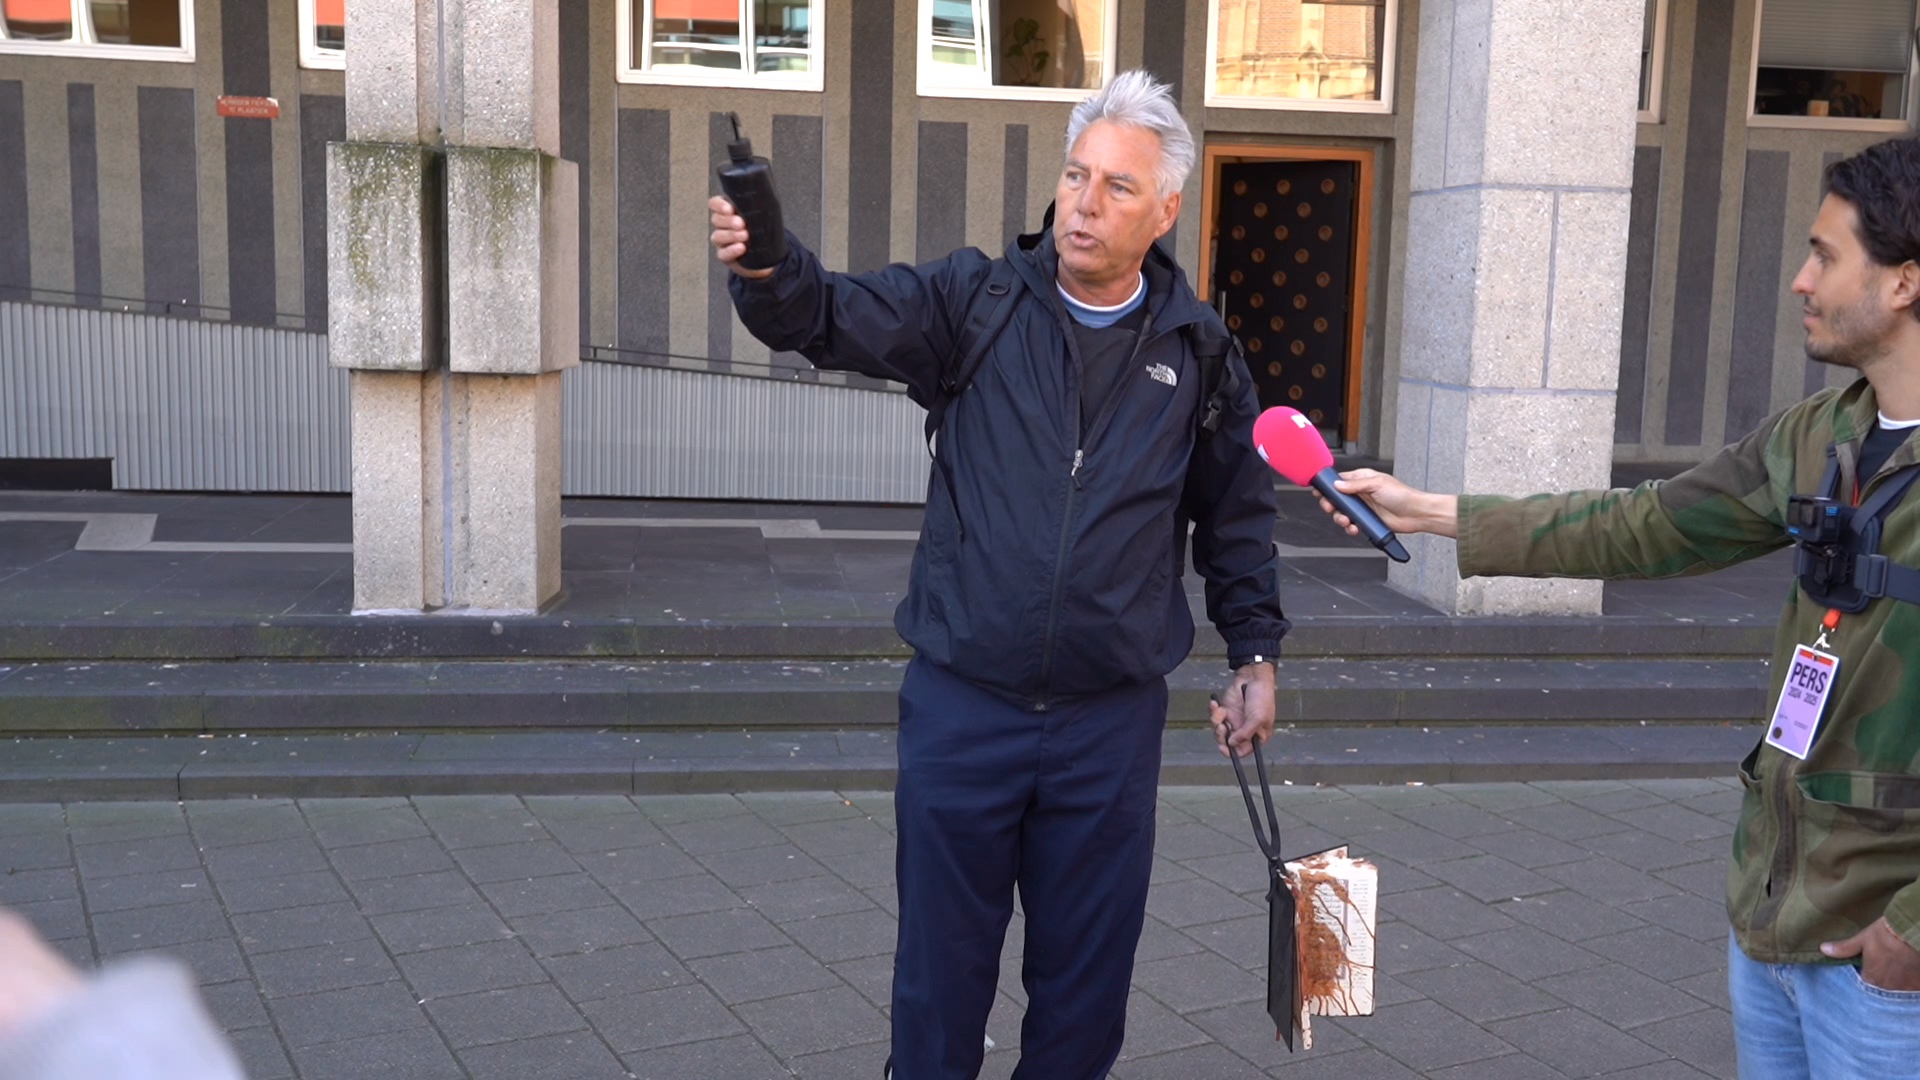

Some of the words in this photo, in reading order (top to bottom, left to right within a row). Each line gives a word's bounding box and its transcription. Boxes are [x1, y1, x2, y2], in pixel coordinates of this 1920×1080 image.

[1145, 365, 1167, 378] NORTH
[1155, 362, 1168, 371] THE
[1150, 372, 1167, 383] FACE
[1790, 662, 1828, 694] PERS
